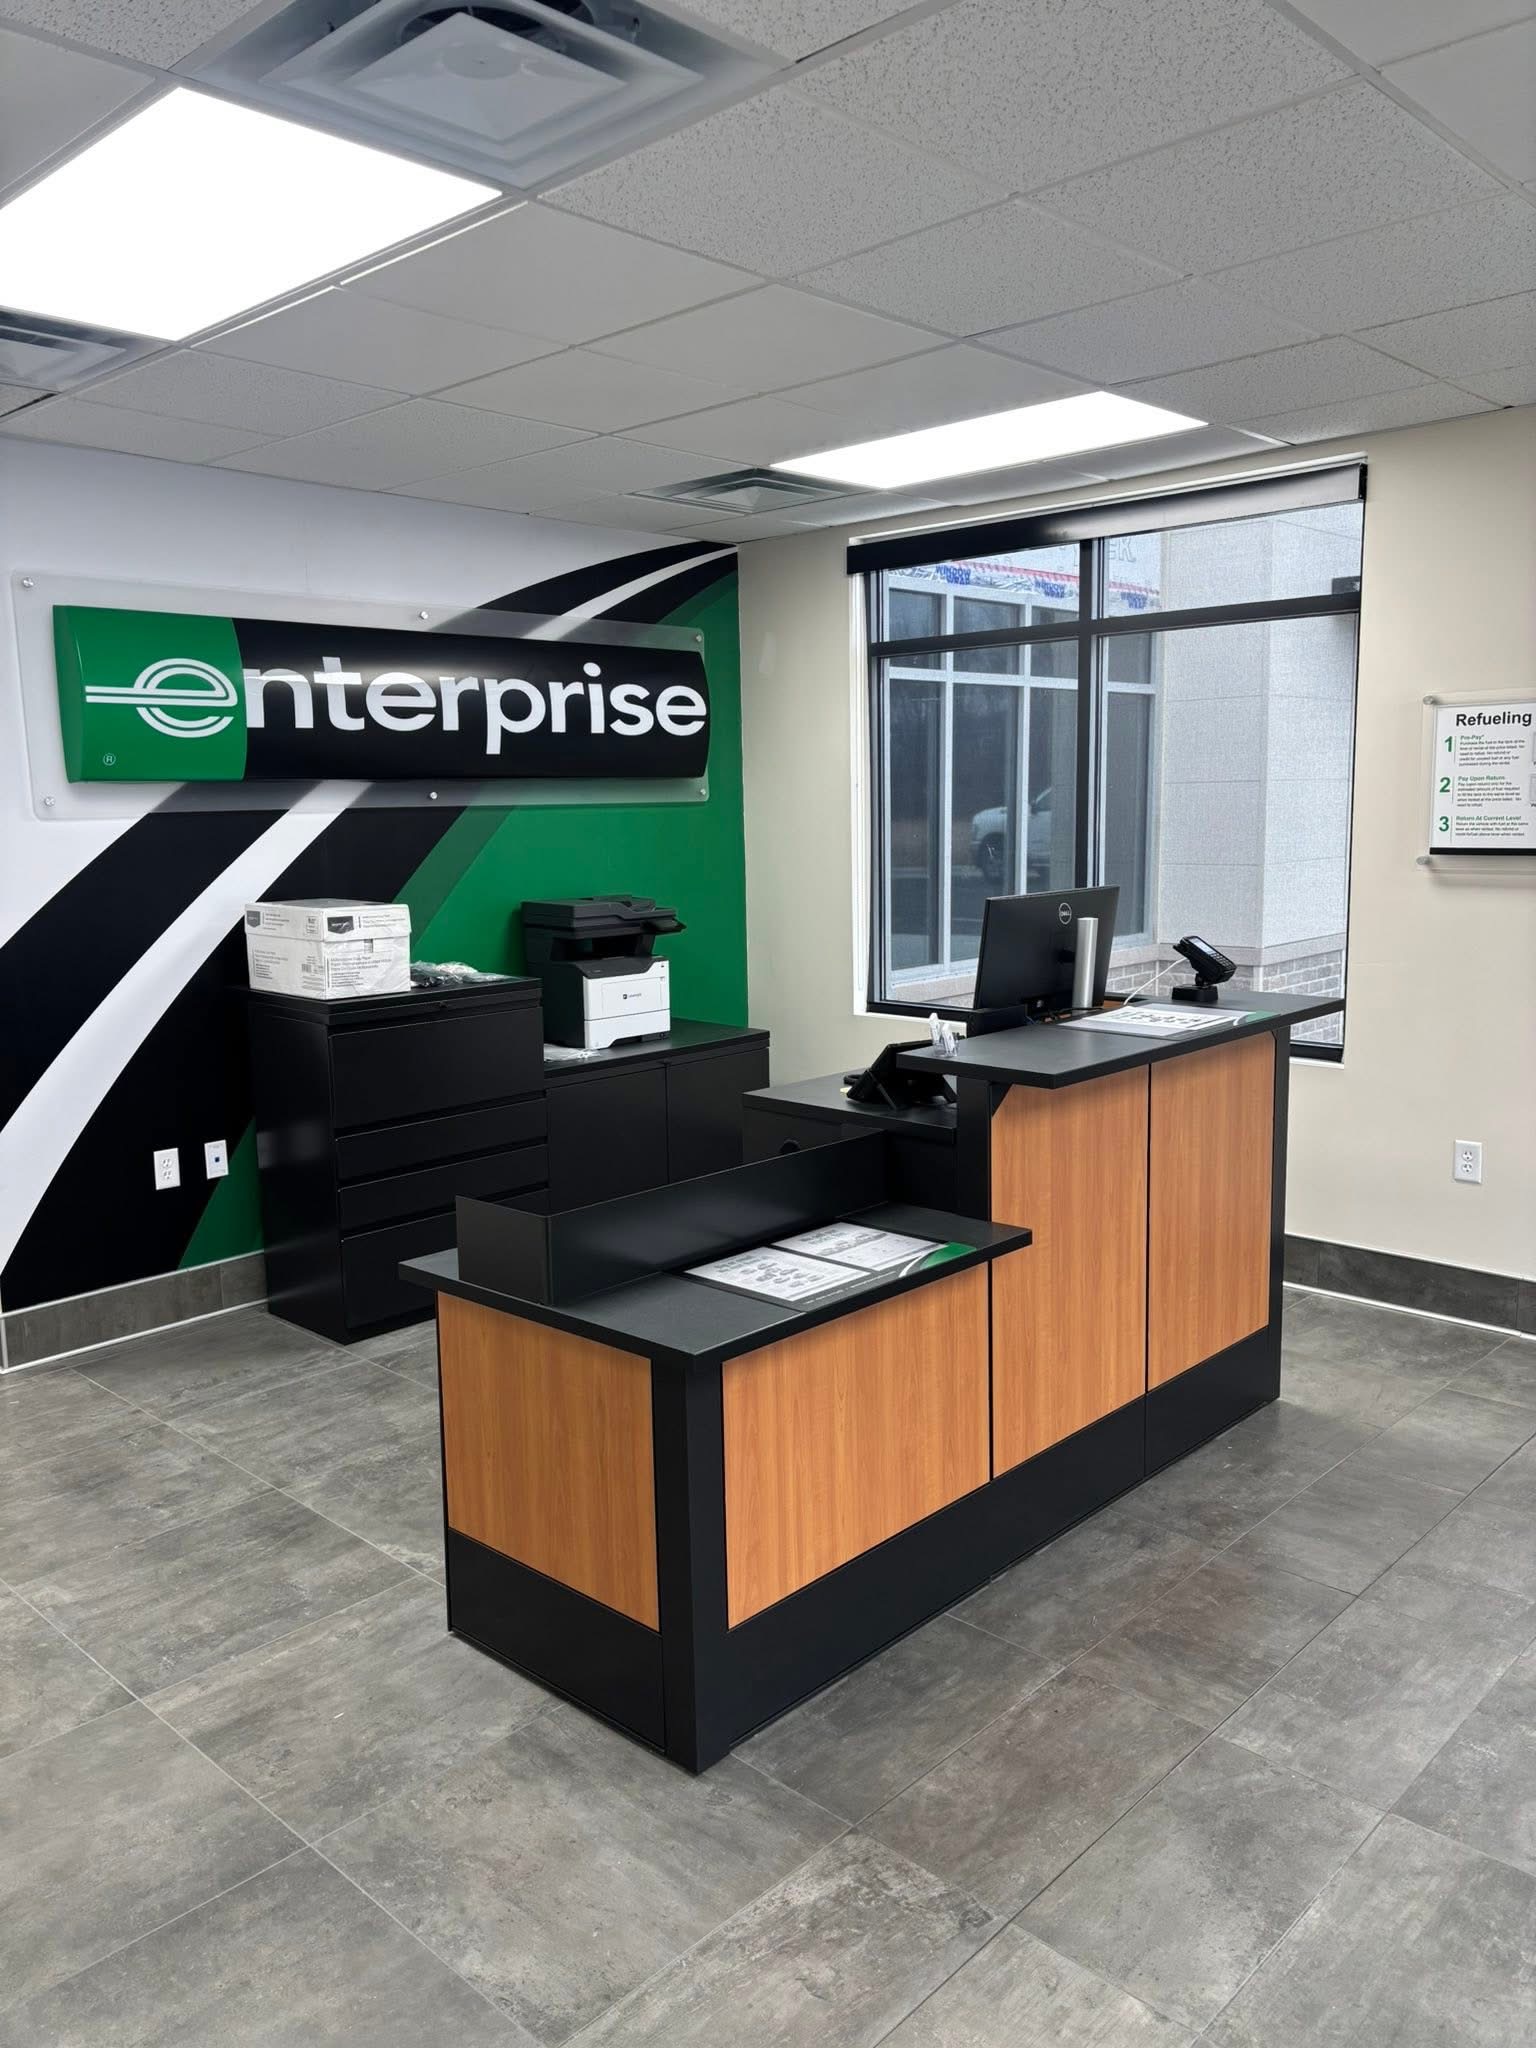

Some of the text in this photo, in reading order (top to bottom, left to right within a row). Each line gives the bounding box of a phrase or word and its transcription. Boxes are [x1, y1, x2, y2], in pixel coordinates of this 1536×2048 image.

[86, 656, 707, 755] enterprise
[1456, 711, 1532, 727] Refueling
[1444, 736, 1453, 752] 1
[1439, 777, 1451, 793] 2
[1438, 815, 1449, 832] 3
